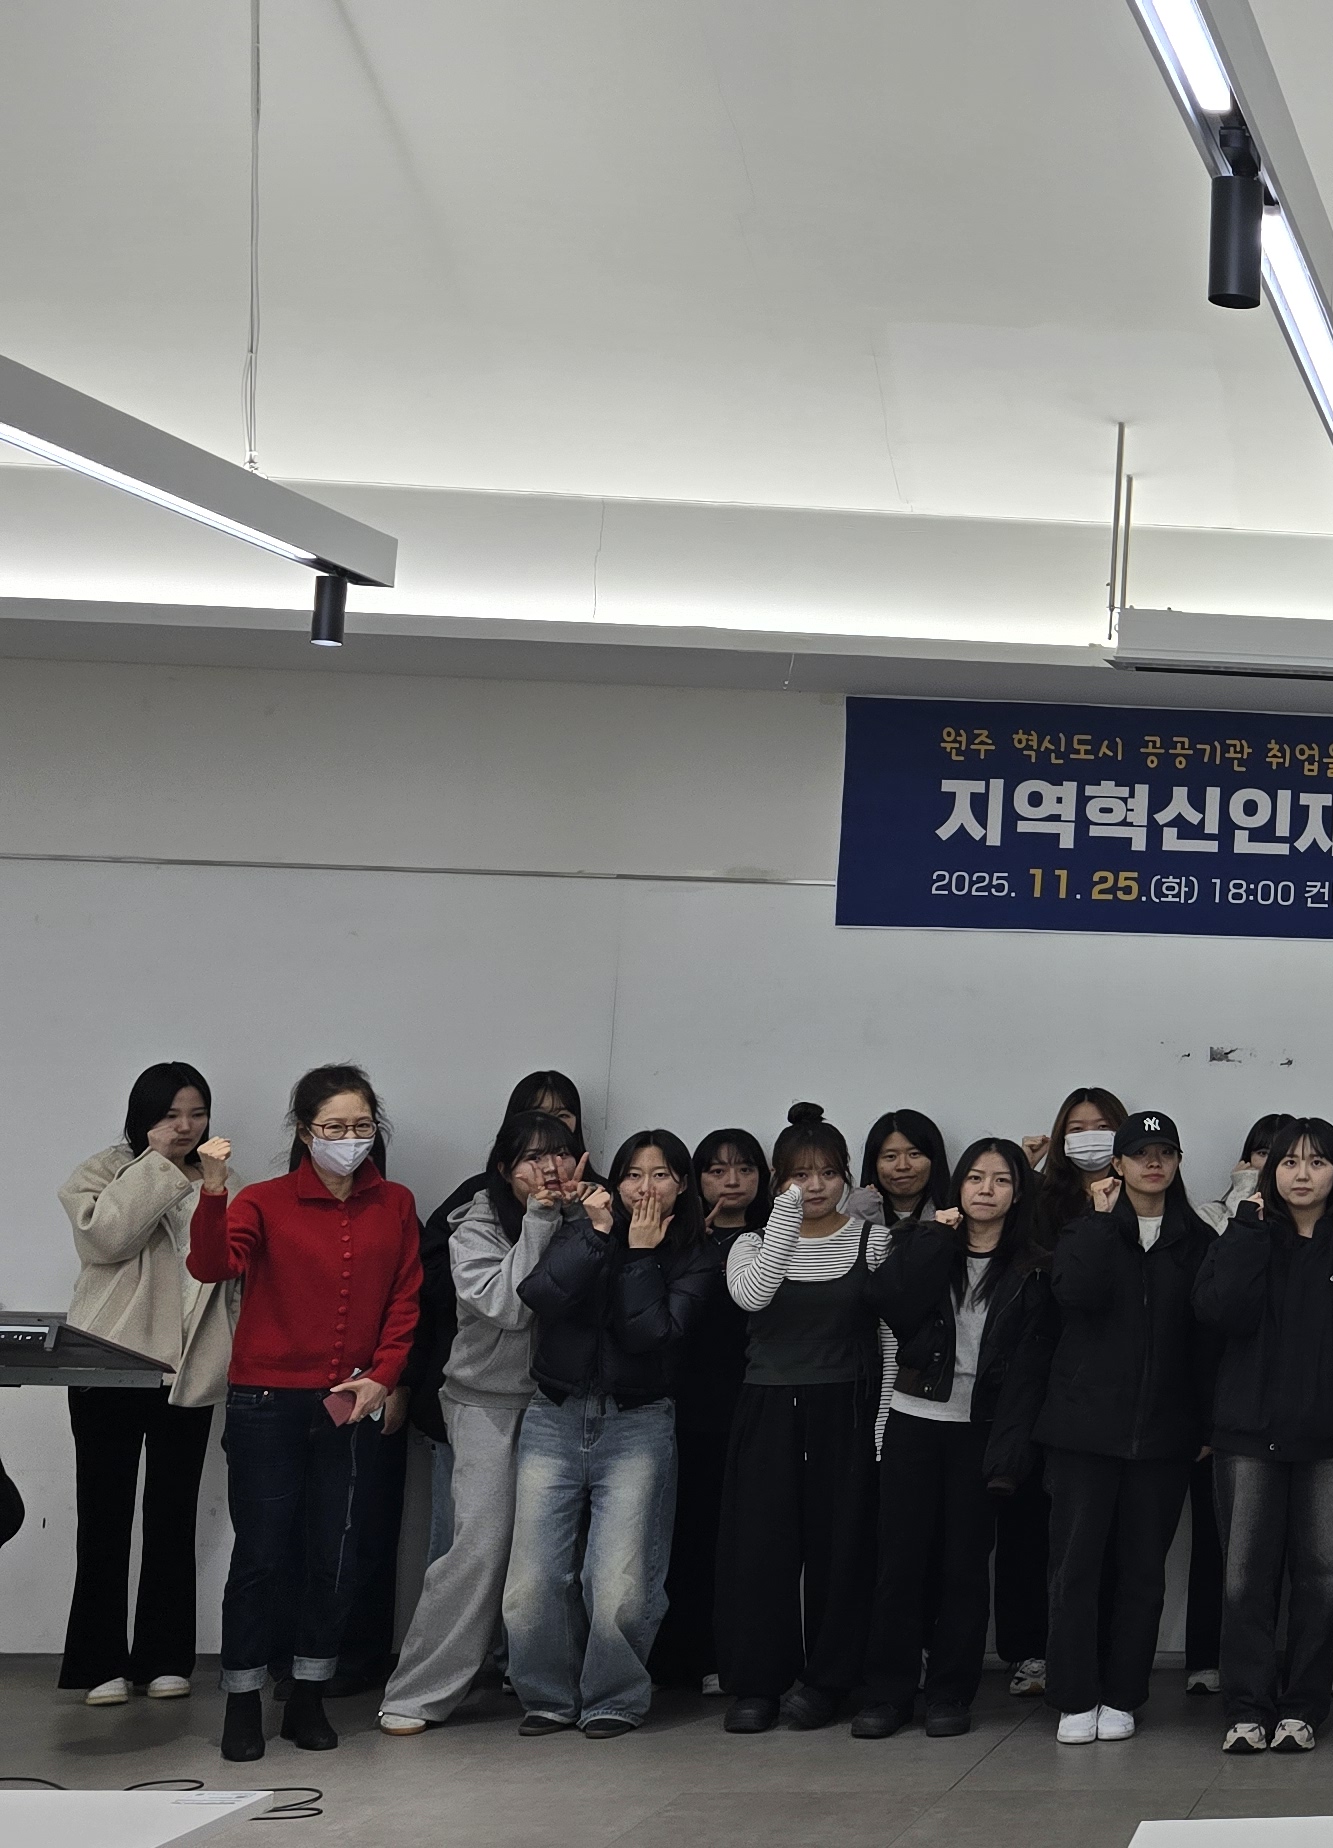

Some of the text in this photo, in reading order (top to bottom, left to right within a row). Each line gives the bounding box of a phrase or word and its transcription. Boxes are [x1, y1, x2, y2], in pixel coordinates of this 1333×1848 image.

[940, 727, 996, 761] 원주
[1012, 729, 1123, 764] 혁신도시
[1140, 735, 1252, 771] 공공기관
[931, 870, 1017, 898] 2025.
[1029, 868, 1082, 900] 11.
[1211, 878, 1296, 906] 18:00
